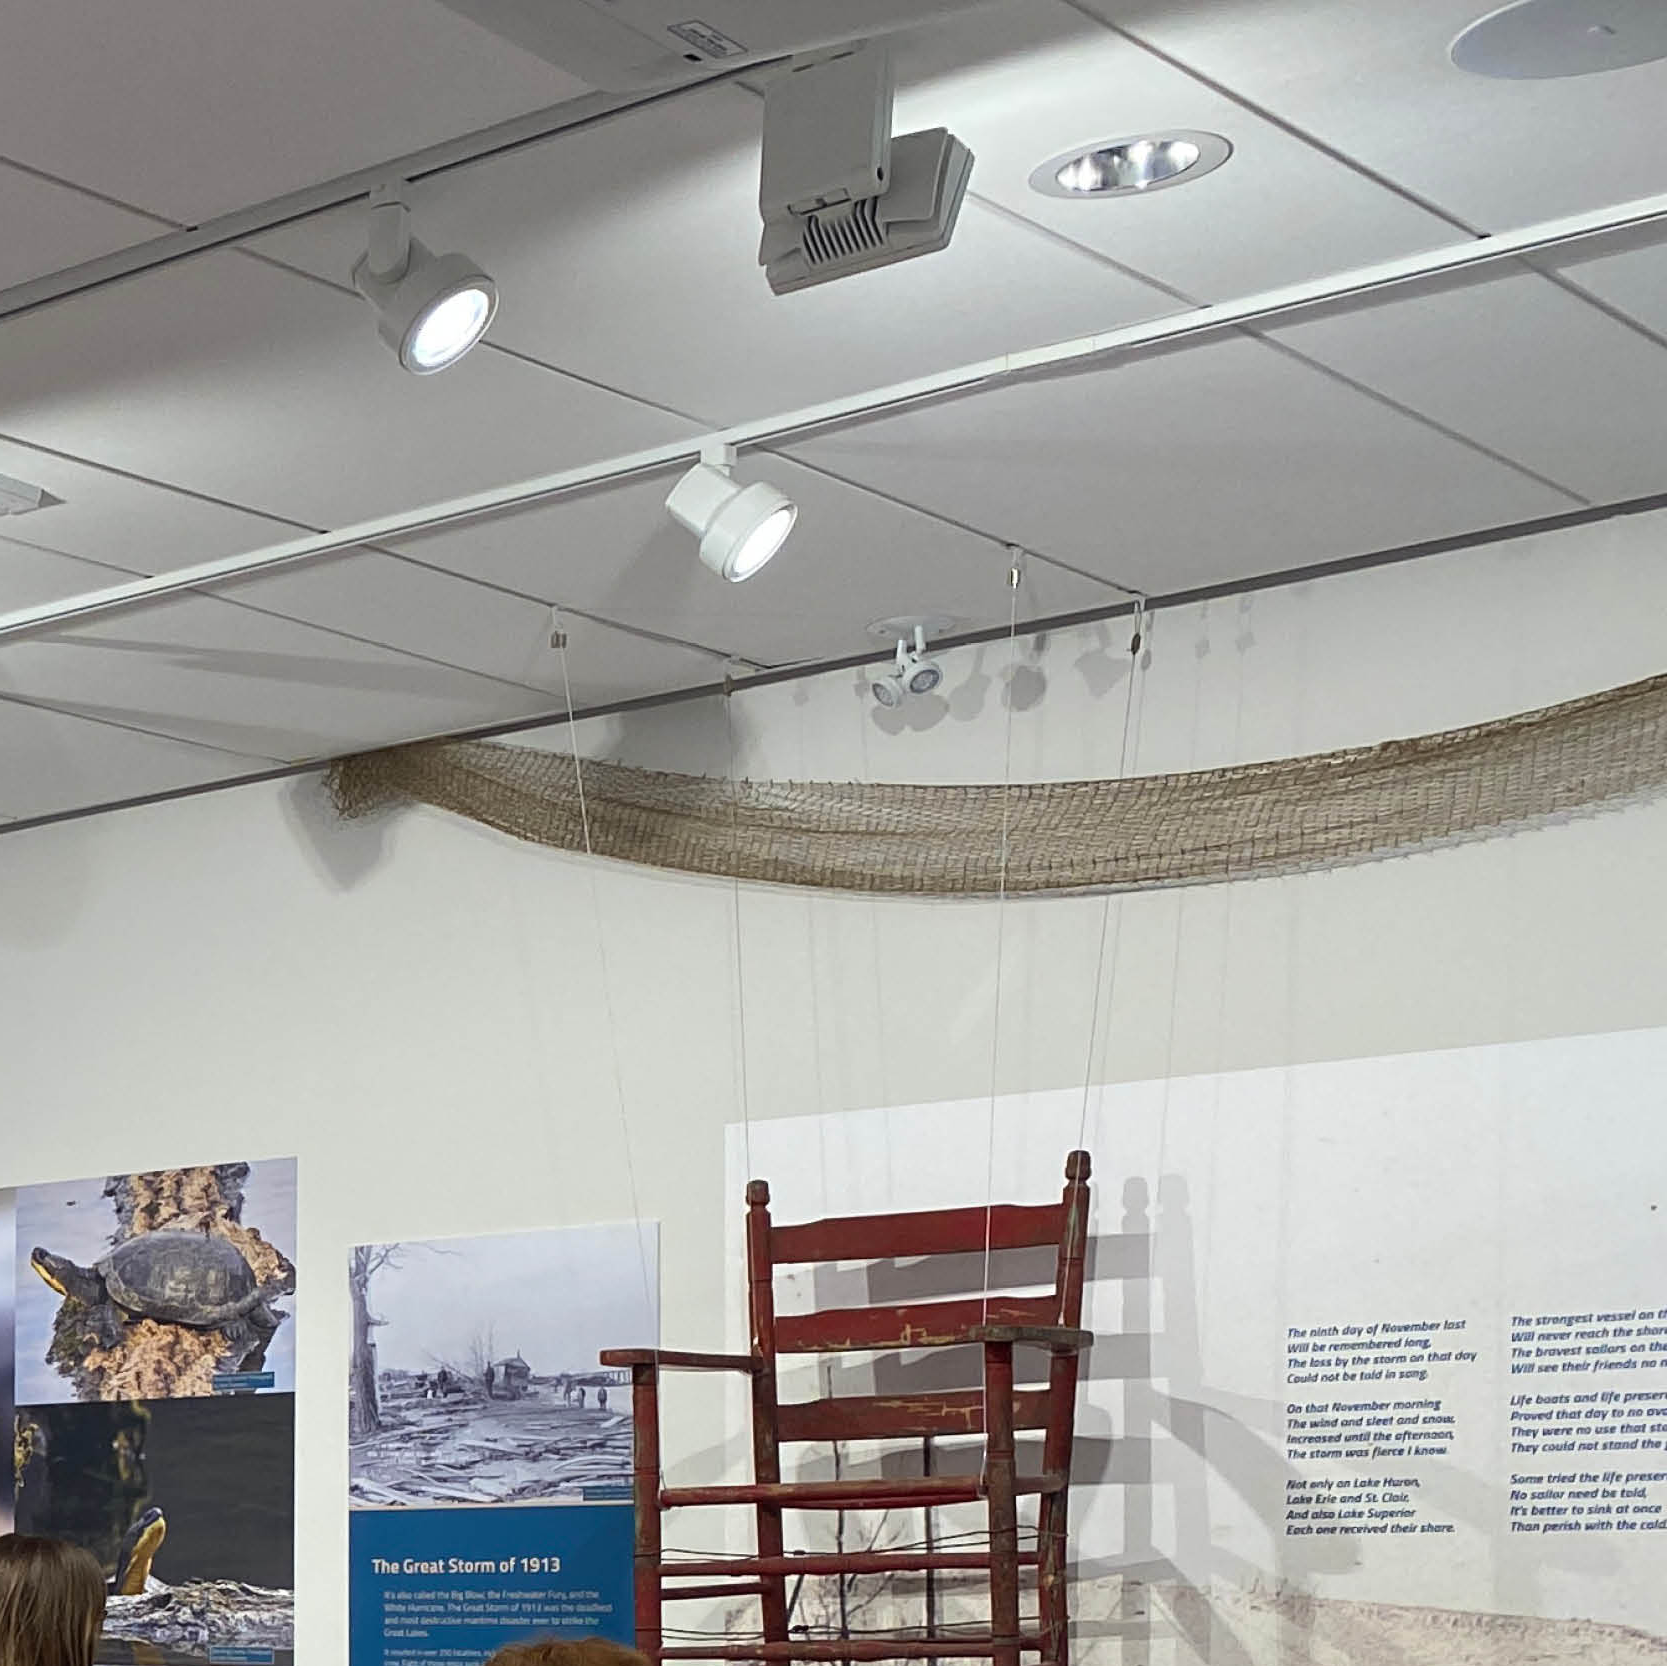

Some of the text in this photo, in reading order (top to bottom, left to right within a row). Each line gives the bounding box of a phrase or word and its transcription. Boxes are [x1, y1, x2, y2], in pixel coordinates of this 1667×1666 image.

[1511, 1315, 1533, 1327] The
[1535, 1313, 1594, 1327] strongest
[1596, 1309, 1637, 1322] vessel
[1637, 1311, 1655, 1320] on
[1287, 1319, 1466, 1339] The ninth day of November last
[1511, 1330, 1535, 1343] Will
[1537, 1331, 1572, 1342] never
[1574, 1326, 1610, 1339] reach
[1612, 1326, 1634, 1338] the
[1287, 1342, 1310, 1354] Will
[1311, 1341, 1327, 1352] be
[1327, 1337, 1403, 1352] remembered
[1511, 1347, 1533, 1359] The
[1534, 1345, 1583, 1358] bravest
[1584, 1343, 1626, 1355] sailors
[1629, 1343, 1646, 1353] on
[1287, 1350, 1478, 1369] The loss by the storm on that day
[1511, 1362, 1535, 1374] Will
[1537, 1363, 1559, 1373] see
[1561, 1359, 1591, 1372] their
[1592, 1357, 1637, 1373] friends
[1640, 1359, 1657, 1369] no
[1286, 1372, 1319, 1384] Could
[1320, 1372, 1340, 1382] not
[1342, 1370, 1357, 1381] be
[1359, 1368, 1383, 1381] told
[1384, 1369, 1396, 1380] in
[1286, 1398, 1442, 1414] On that November morning
[1509, 1394, 1533, 1408] Life
[1535, 1393, 1570, 1405] boats
[1573, 1391, 1599, 1403] and
[1600, 1390, 1621, 1405] life
[1287, 1418, 1307, 1430] The
[1309, 1417, 1339, 1429] wind
[1340, 1416, 1364, 1427] and
[1365, 1415, 1394, 1426] sleet
[1396, 1413, 1420, 1425] and
[1509, 1409, 1554, 1421] Proved
[1555, 1408, 1582, 1420] that
[1584, 1407, 1609, 1421] day
[1610, 1408, 1625, 1418] to
[1626, 1408, 1644, 1417] no
[1286, 1432, 1343, 1444] Increased
[1343, 1431, 1371, 1443] until
[1372, 1431, 1393, 1442] the
[1511, 1426, 1539, 1439] They
[1541, 1426, 1574, 1437] were
[1575, 1426, 1592, 1435] no
[1594, 1425, 1617, 1435] use
[1619, 1423, 1647, 1434] that
[1287, 1448, 1307, 1459] The
[1309, 1449, 1343, 1459] storm
[1345, 1445, 1371, 1458] was
[1371, 1445, 1405, 1460] fierce
[1407, 1445, 1412, 1456] I
[1511, 1442, 1540, 1455] They
[1541, 1440, 1576, 1452] could
[1577, 1440, 1599, 1451] not
[1600, 1438, 1639, 1451] stand
[1640, 1438, 1662, 1449] the
[1286, 1477, 1421, 1492] Not only on Lake Huron,
[1509, 1473, 1544, 1485] Some
[1546, 1472, 1577, 1484] tried
[1578, 1472, 1600, 1483] the
[1601, 1471, 1623, 1485] life
[1286, 1493, 1313, 1505] Lake
[1314, 1493, 1337, 1505] Erie
[1339, 1492, 1363, 1504] and
[1509, 1486, 1647, 1501] No sailor need be told,
[1285, 1507, 1416, 1521] And also Lake Superior
[1509, 1503, 1662, 1516] It's better to sink at once
[1285, 1524, 1314, 1536] Each
[1314, 1526, 1338, 1535] one
[1338, 1522, 1389, 1535] received
[1389, 1522, 1418, 1534] their
[1510, 1521, 1540, 1532] Than
[1542, 1519, 1582, 1535] perish
[1584, 1519, 1613, 1531] with
[1616, 1519, 1637, 1530] the
[372, 1557, 560, 1574] The Great Storm of 1913
